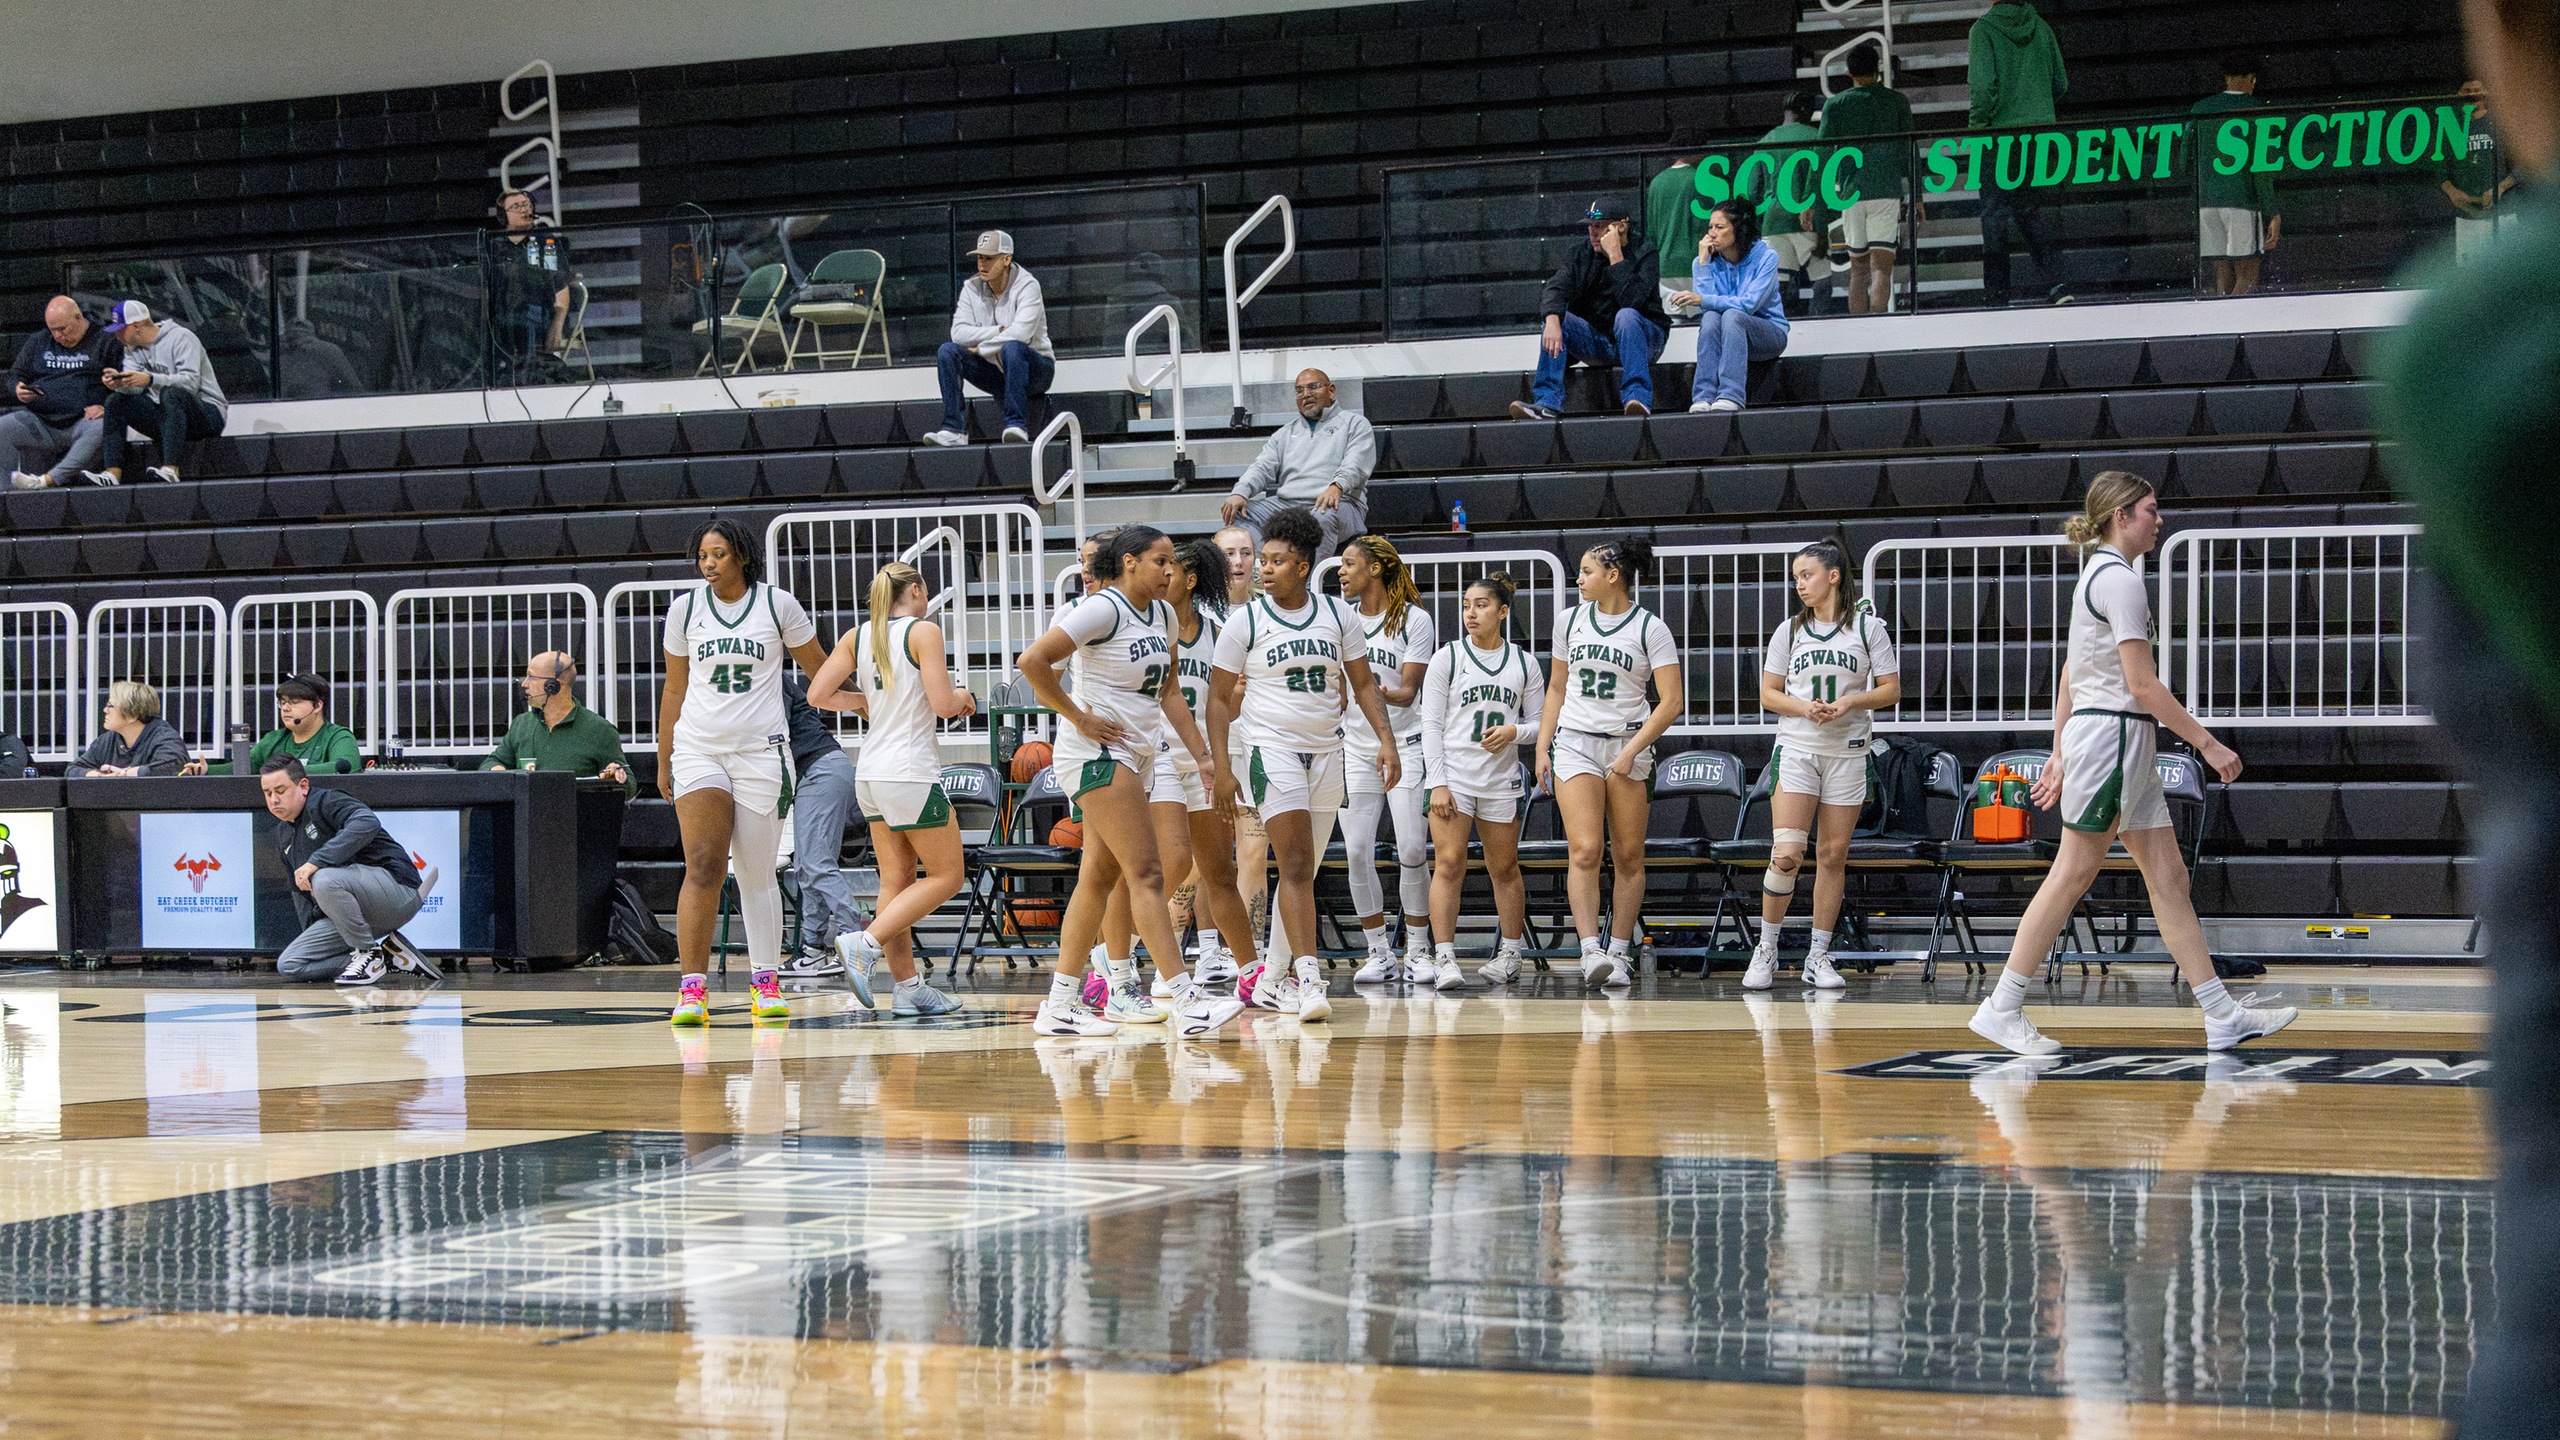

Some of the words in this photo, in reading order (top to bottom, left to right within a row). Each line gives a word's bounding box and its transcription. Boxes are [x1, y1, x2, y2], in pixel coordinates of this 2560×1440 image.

[1690, 147, 1863, 219] SCCC
[1924, 123, 2182, 193] STUDENT
[2213, 104, 2475, 175] SECTION
[698, 638, 765, 662] SEWARD
[1267, 639, 1337, 667] SEWARD
[1570, 644, 1633, 672] SEWARD
[1794, 650, 1857, 675] SEWARD
[708, 664, 753, 694] 45
[1579, 668, 1617, 699] 22
[1811, 675, 1837, 704] 11
[1461, 684, 1517, 709] SEWARD
[1670, 764, 1722, 781] SAINTS
[174, 896, 198, 906] CREEK
[200, 896, 238, 906] BUTCHERY
